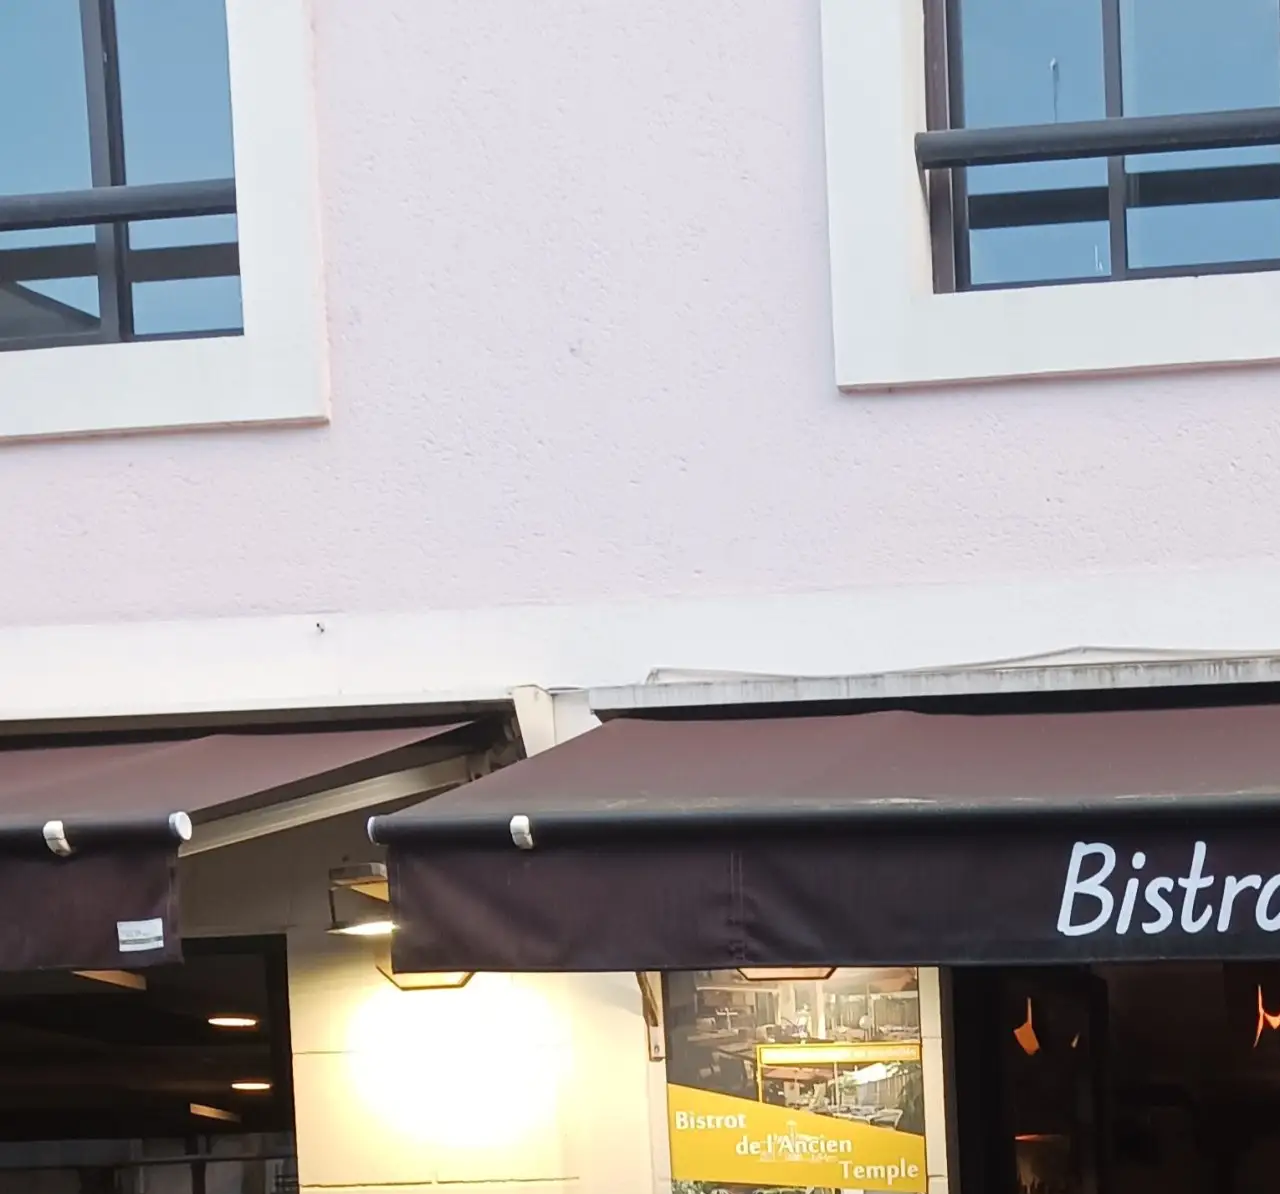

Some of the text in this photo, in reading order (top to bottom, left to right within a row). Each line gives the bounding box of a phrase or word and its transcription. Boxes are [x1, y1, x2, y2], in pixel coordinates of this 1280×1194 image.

[675, 1111, 747, 1130] Bistrot
[735, 1132, 853, 1155] de l'Ancien
[838, 1157, 920, 1185] Temple
